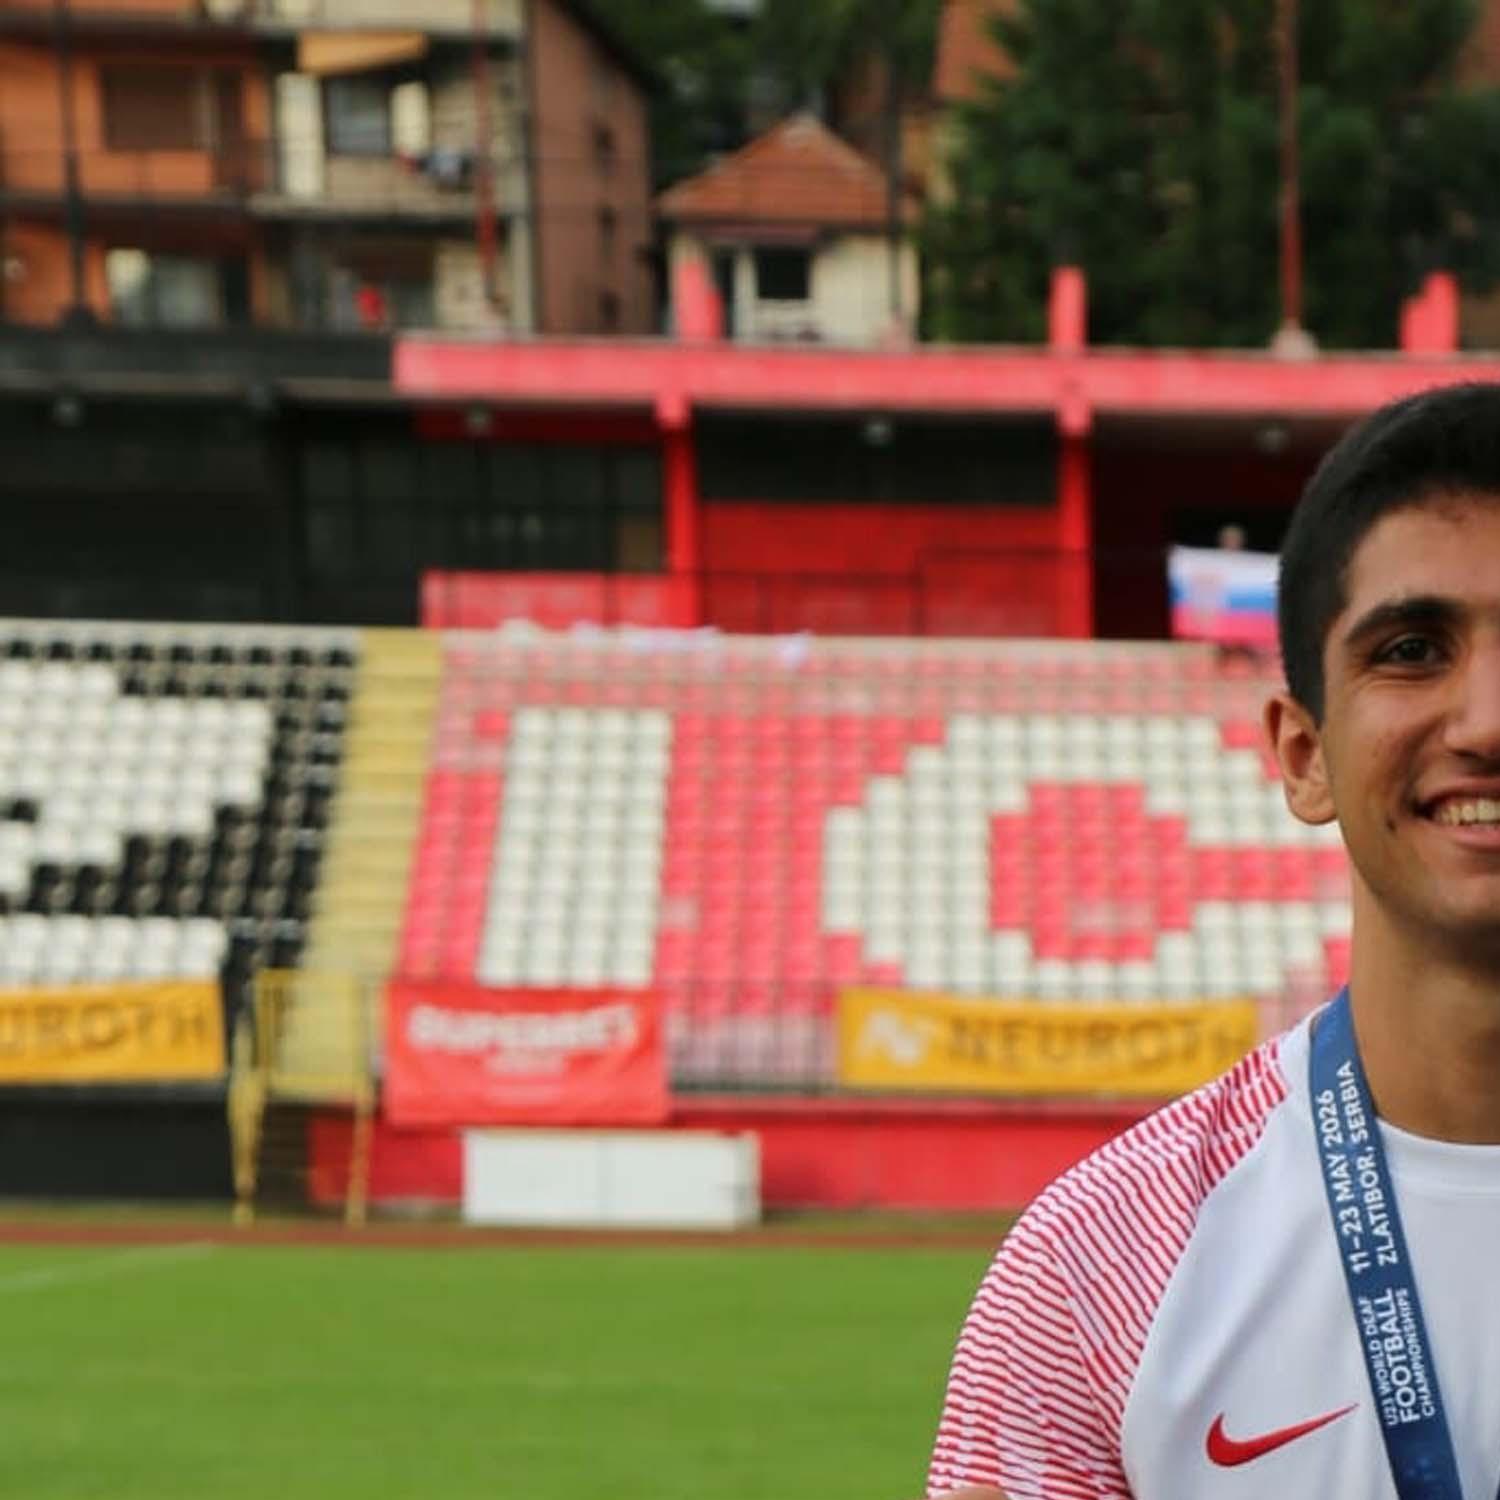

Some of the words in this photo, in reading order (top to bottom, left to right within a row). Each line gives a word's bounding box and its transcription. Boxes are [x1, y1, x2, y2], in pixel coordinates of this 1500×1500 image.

[1316, 1089, 1343, 1148] 2026
[1336, 1060, 1368, 1144] SERBIA
[1326, 1153, 1354, 1202] MAY
[1357, 1146, 1399, 1266] ZLATIBOR,
[1358, 1296, 1380, 1336] DEAF
[1368, 1340, 1392, 1396] WORLD
[1374, 1287, 1420, 1423] FOOTBALL
[1395, 1288, 1435, 1417] CHAMPIONSHIPS
